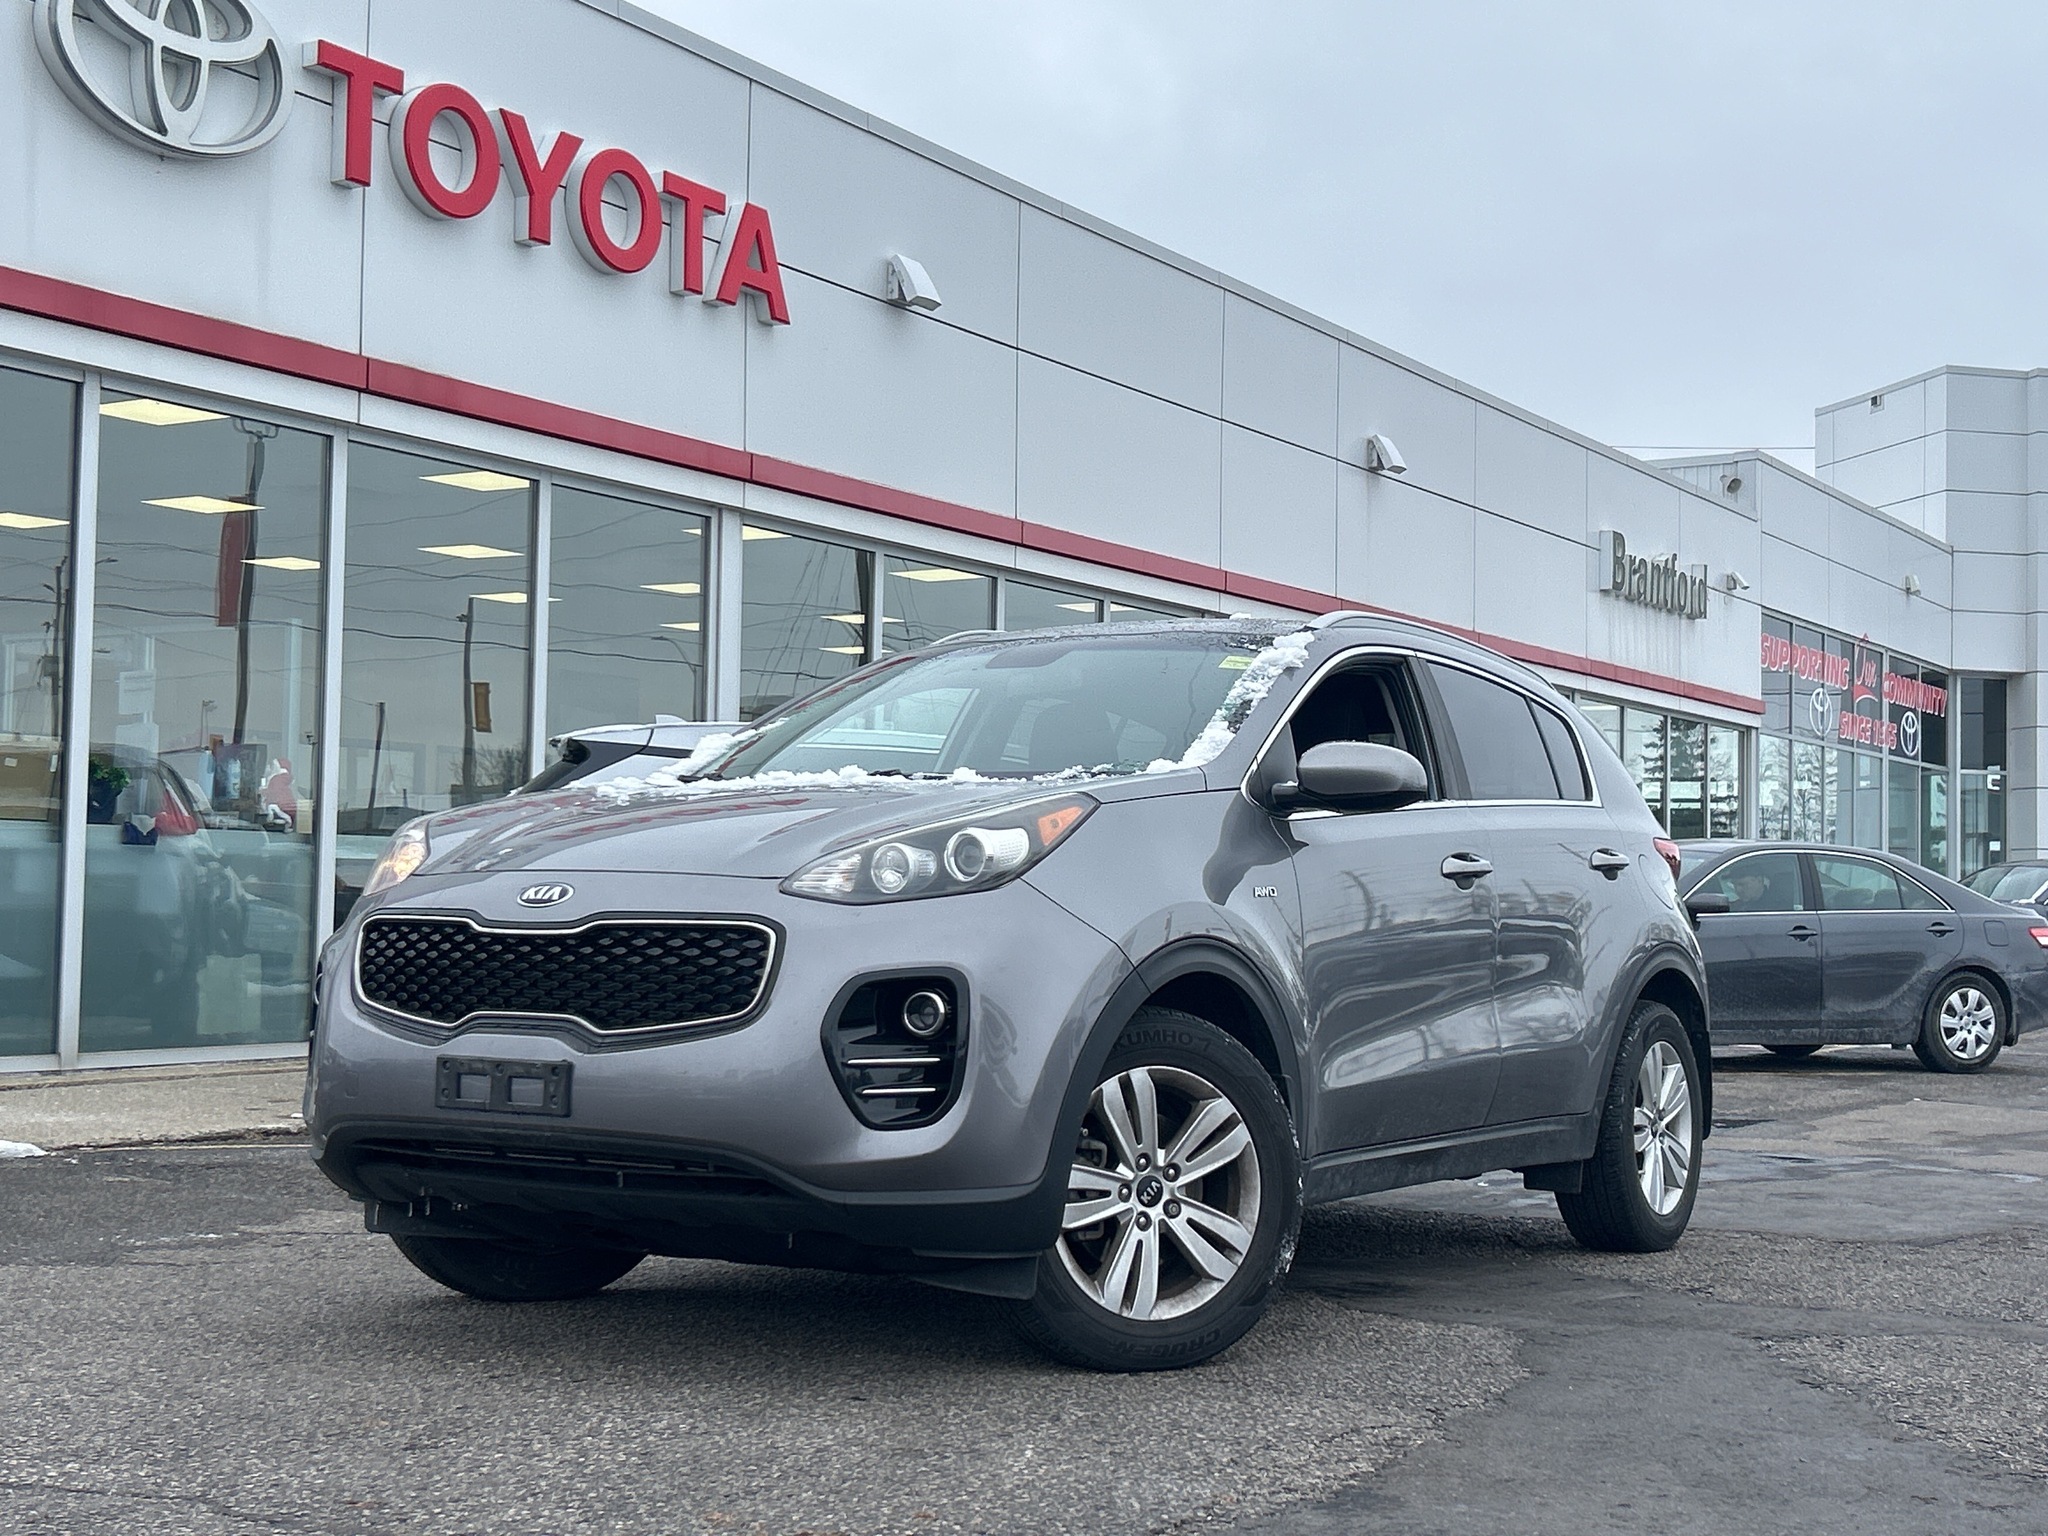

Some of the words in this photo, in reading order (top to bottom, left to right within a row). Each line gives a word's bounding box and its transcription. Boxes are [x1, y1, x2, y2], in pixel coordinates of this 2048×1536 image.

[301, 39, 791, 327] TOYOTA
[1606, 530, 1708, 620] Brantford
[1761, 633, 1850, 690] SUPPORTING
[1882, 672, 1948, 718] COMMUNITY
[1840, 711, 1872, 744] SINCE
[521, 885, 563, 900] KIA
[1253, 886, 1278, 898] AWD
[1140, 1181, 1161, 1204] KIA
